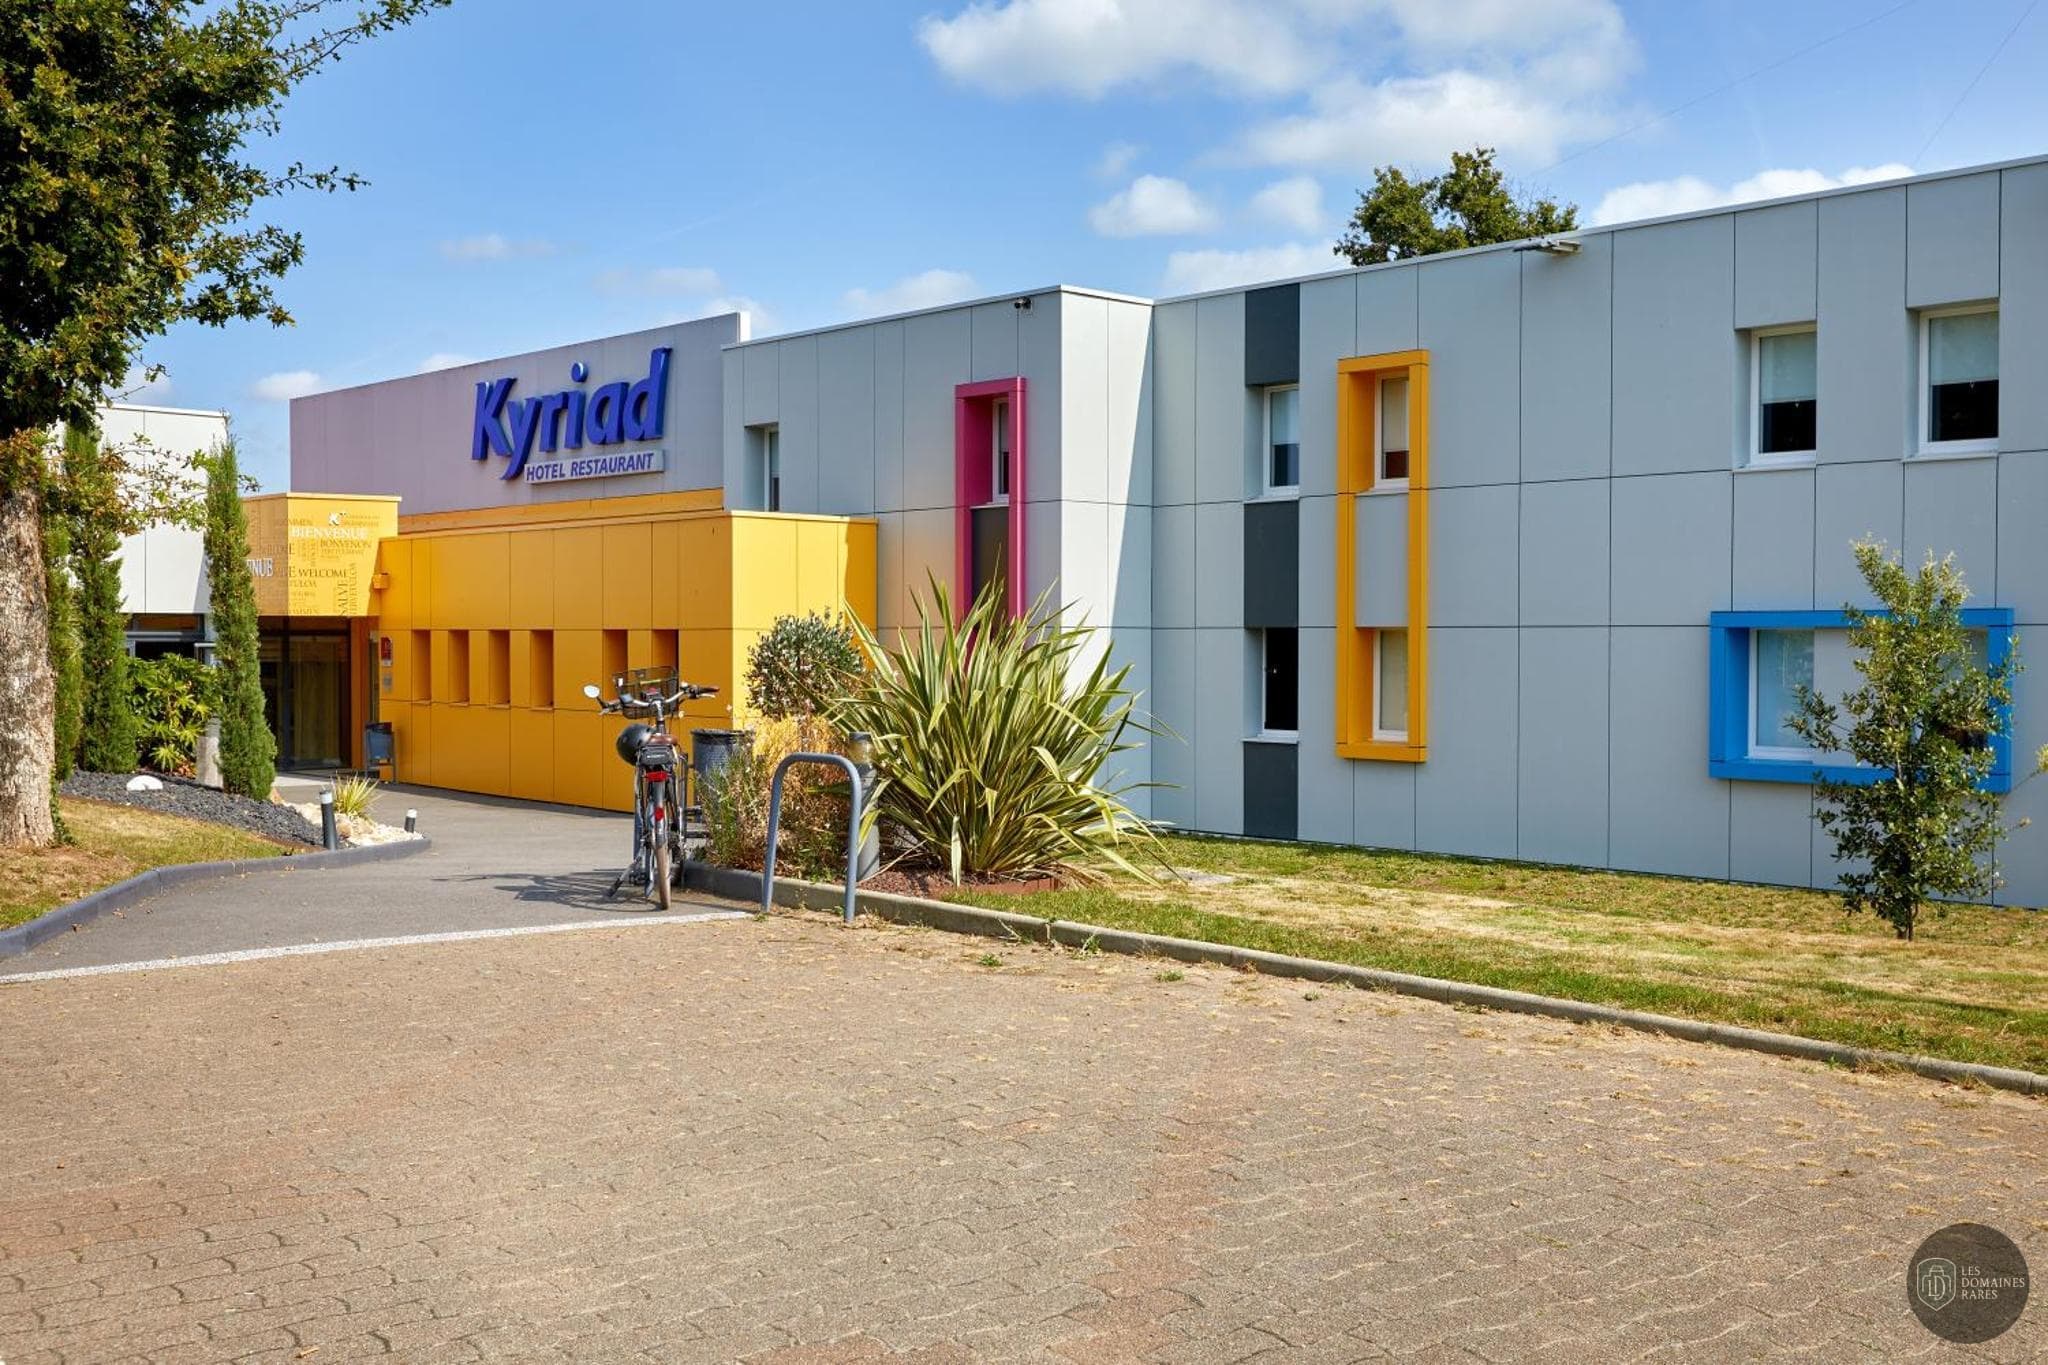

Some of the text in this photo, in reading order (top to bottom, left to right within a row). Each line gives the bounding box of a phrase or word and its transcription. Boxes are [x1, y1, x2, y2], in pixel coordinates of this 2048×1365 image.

[472, 347, 672, 480] Kyriad
[526, 452, 654, 481] HOTEL RESTAURANT
[298, 567, 349, 578] WELCOME
